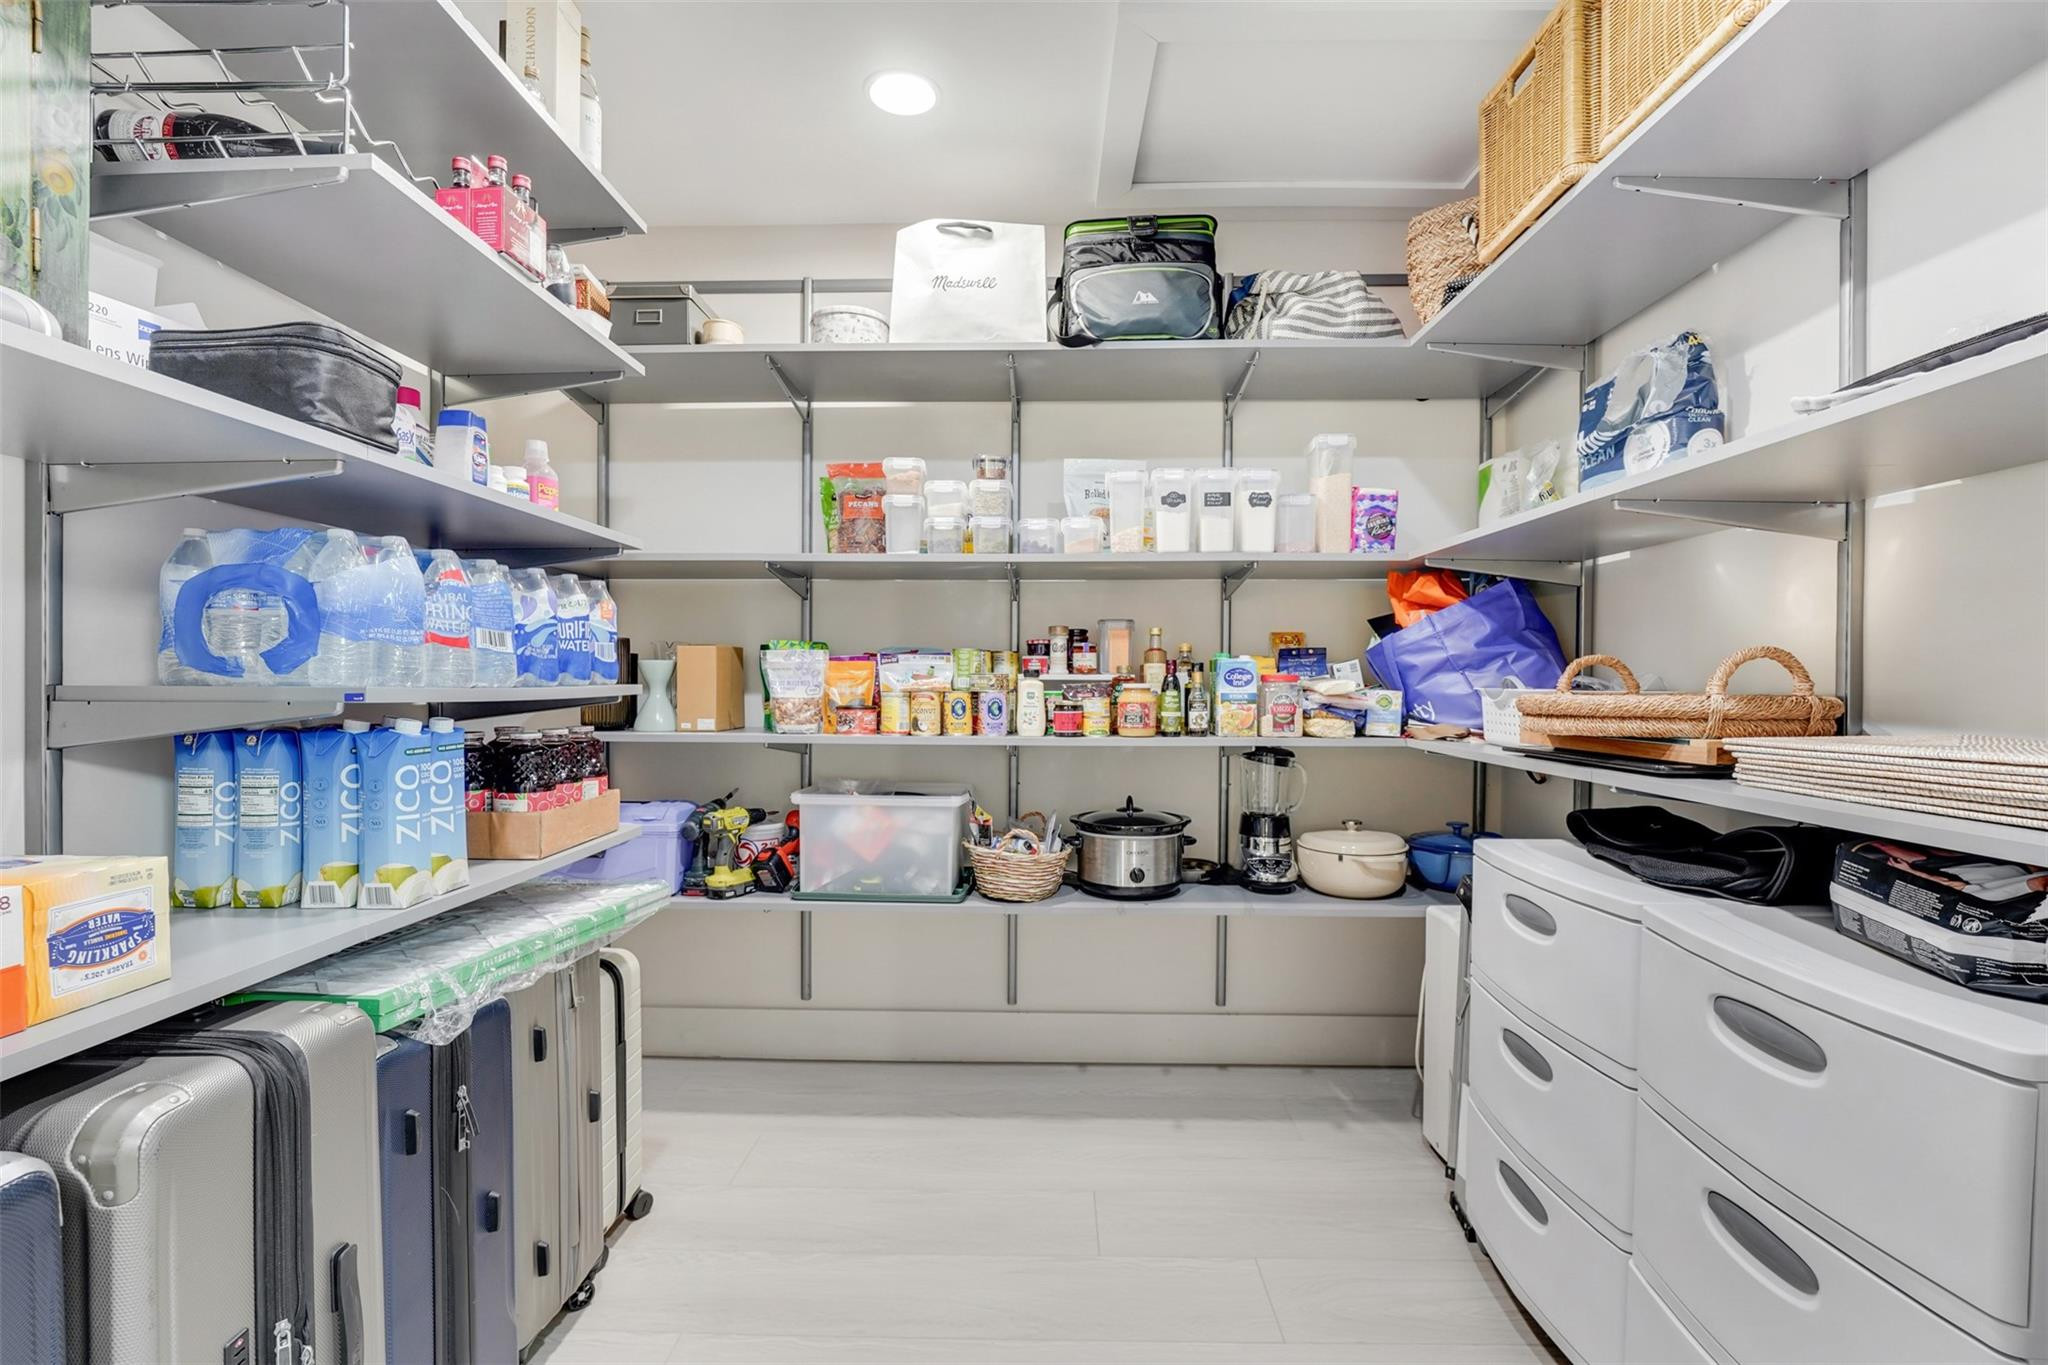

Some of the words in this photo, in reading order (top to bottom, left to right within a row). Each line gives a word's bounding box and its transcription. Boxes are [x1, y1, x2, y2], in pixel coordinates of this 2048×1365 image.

[1084, 488, 1106, 500] Rolled
[558, 639, 590, 652] WATE
[1225, 672, 1252, 682] College
[1232, 679, 1245, 687] Inn
[395, 763, 421, 845] ZICO
[430, 760, 456, 836] ZICO
[88, 912, 122, 929] WATER
[67, 931, 142, 965] SPARKLING
